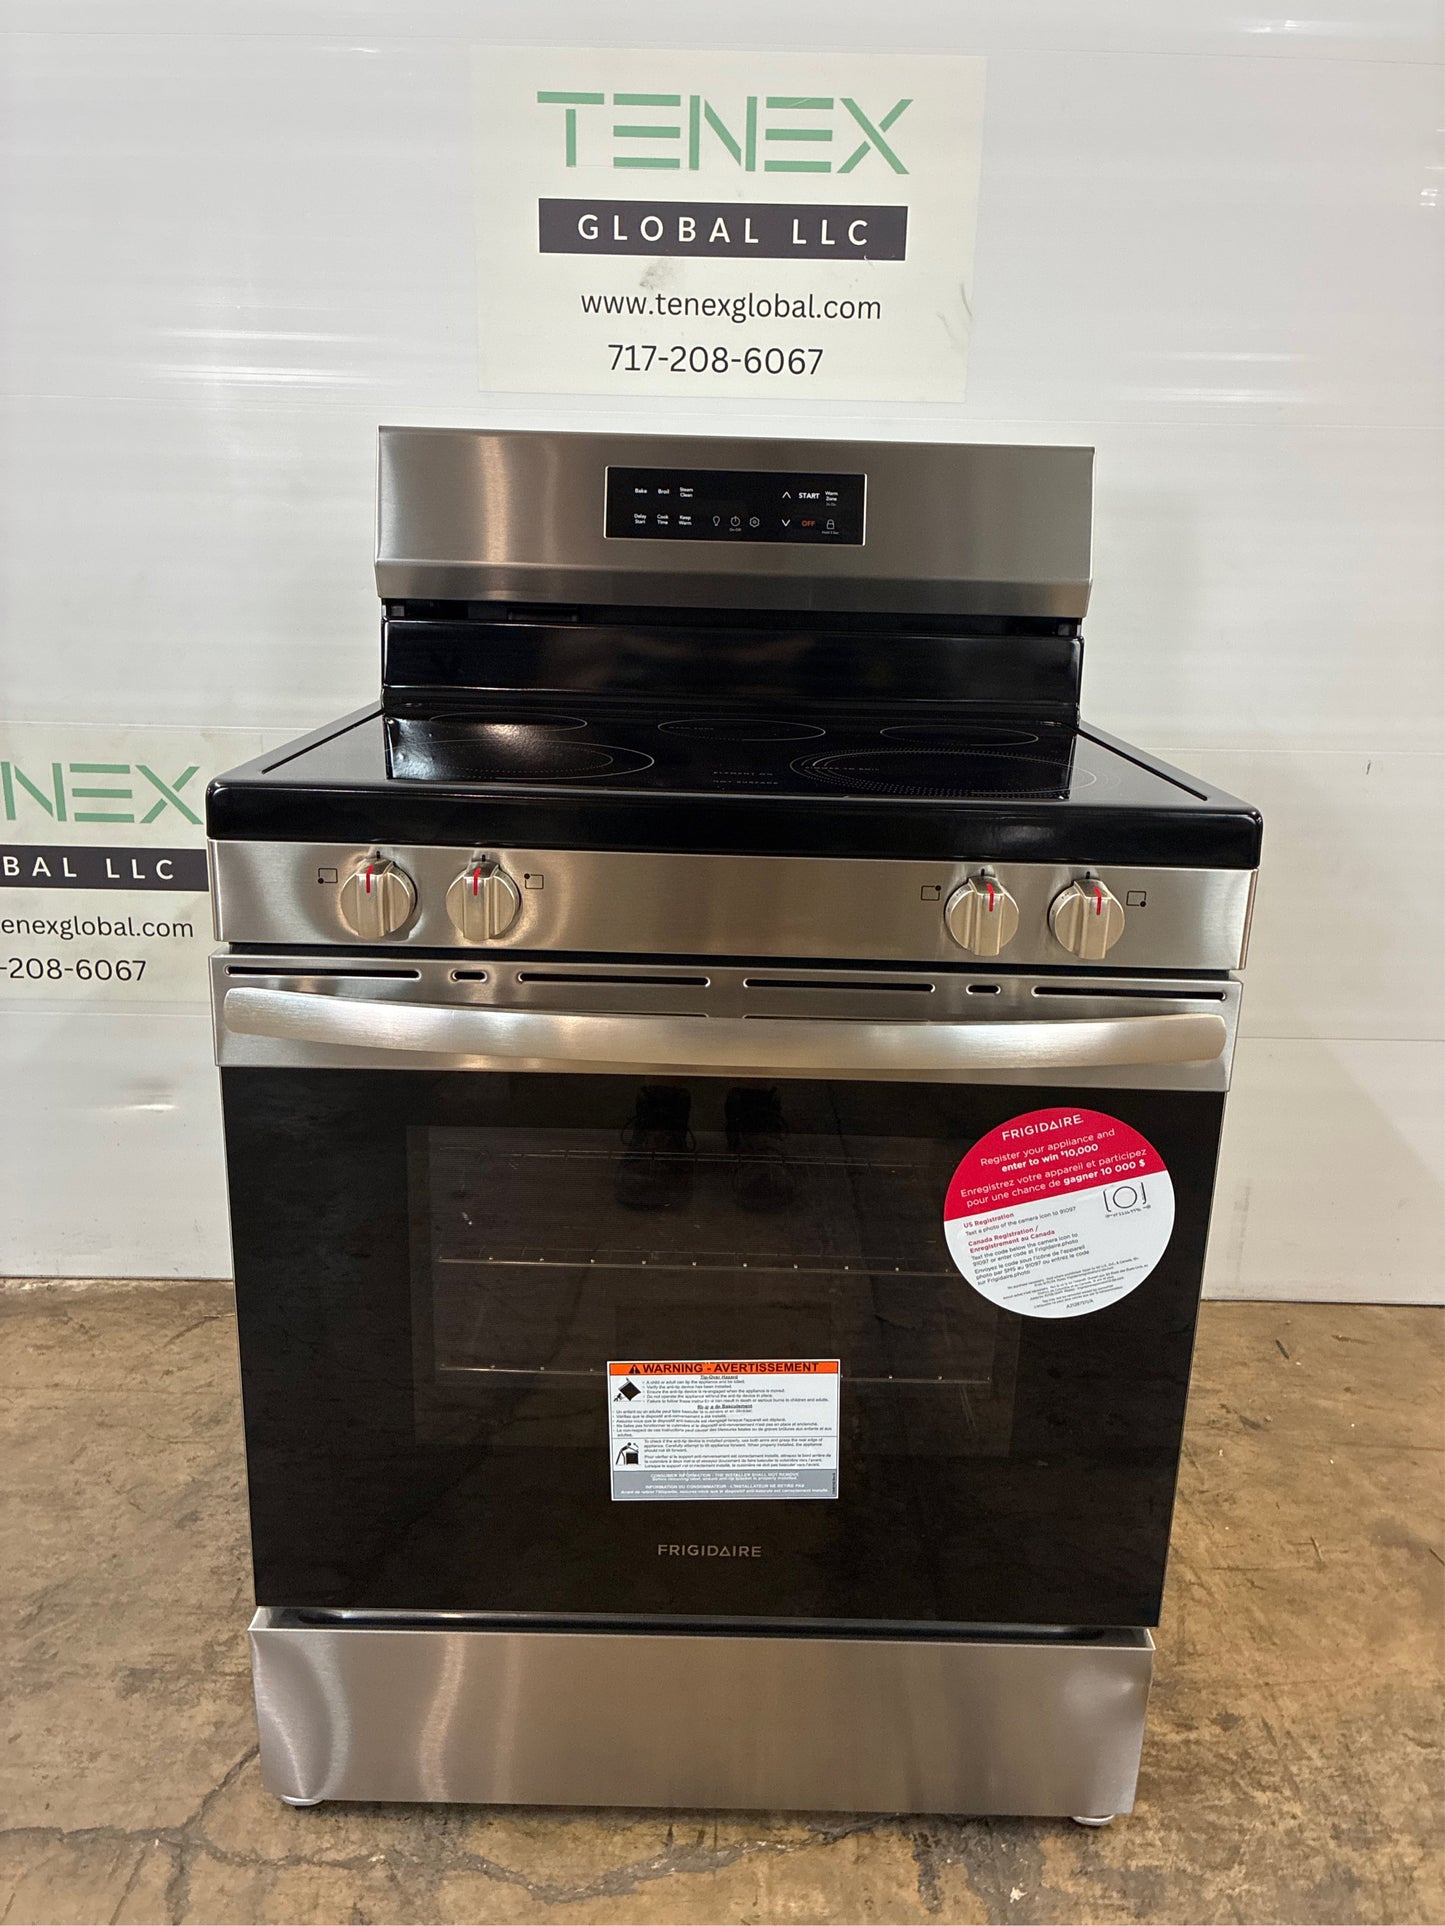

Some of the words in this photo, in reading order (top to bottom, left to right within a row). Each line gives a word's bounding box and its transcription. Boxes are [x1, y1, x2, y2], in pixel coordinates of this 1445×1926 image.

[537, 91, 913, 174] TENEX
[577, 214, 759, 244] GLOBAL
[792, 218, 869, 246] LLC
[581, 293, 882, 323] www.tenexglobal.com
[608, 344, 824, 374] 717-208-6067
[798, 492, 820, 500] START
[0, 761, 203, 825] NEX
[3, 856, 78, 878] BAL
[105, 858, 174, 880] LLC
[1001, 1114, 1083, 1140] FRIGIDAIRE
[980, 1151, 1019, 1166] Register
[1022, 1146, 1044, 1157] your
[1047, 1134, 1093, 1150] appliance
[1096, 1128, 1114, 1139] and
[1001, 1161, 1026, 1171] enter
[1041, 1153, 1058, 1162] win
[1060, 1143, 1098, 1157] $10,000
[960, 1179, 1014, 1197] Enregistrez
[1016, 1173, 1041, 1183] votre
[1044, 1162, 1083, 1177] appareil
[1085, 1159, 1095, 1168] et
[1098, 1148, 1146, 1166] participez
[966, 1196, 988, 1208] pour
[991, 1191, 1009, 1201] une
[1011, 1183, 1045, 1196] chance
[1048, 1179, 1060, 1187] de
[1063, 1171, 1097, 1185] gagner
[1100, 1166, 1112, 1175] 10
[1114, 1161, 1136, 1172] 000
[1138, 1158, 1145, 1166] $
[974, 1212, 1014, 1225] Registration
[968, 1237, 992, 1246] Canada
[993, 1227, 1033, 1240] Registration
[1034, 1224, 1038, 1232] /
[969, 1237, 1019, 1253] Enregistrement
[1030, 1229, 1055, 1239] Canada
[642, 1363, 703, 1373] WARNING
[713, 1362, 818, 1372] AVERTISSEMENT
[657, 1544, 762, 1558] FRIGIDAIRE
